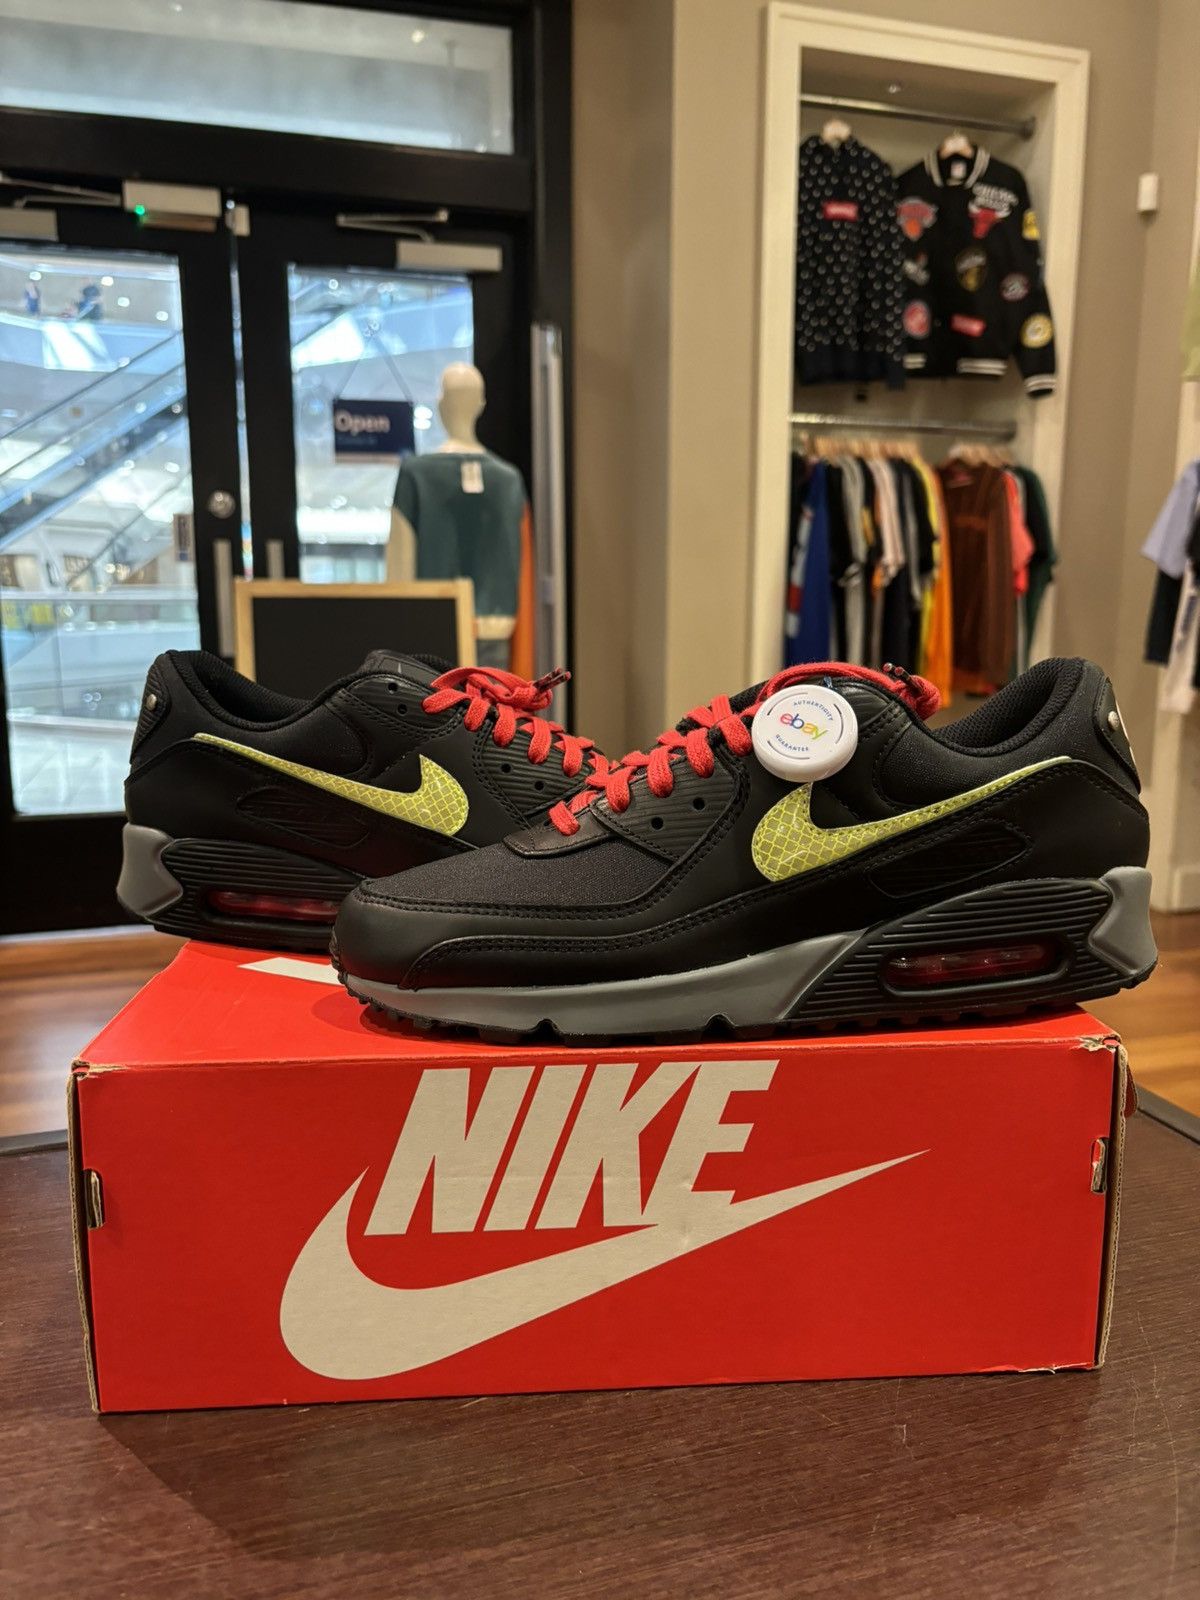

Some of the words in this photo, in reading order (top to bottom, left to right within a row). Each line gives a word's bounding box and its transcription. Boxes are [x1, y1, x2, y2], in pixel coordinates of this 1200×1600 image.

[334, 409, 391, 436] Open
[793, 699, 833, 721] AUTHENTICITY
[780, 713, 828, 740] ebay
[775, 733, 809, 752] GUARANTEE
[364, 1059, 780, 1236] NIKE
